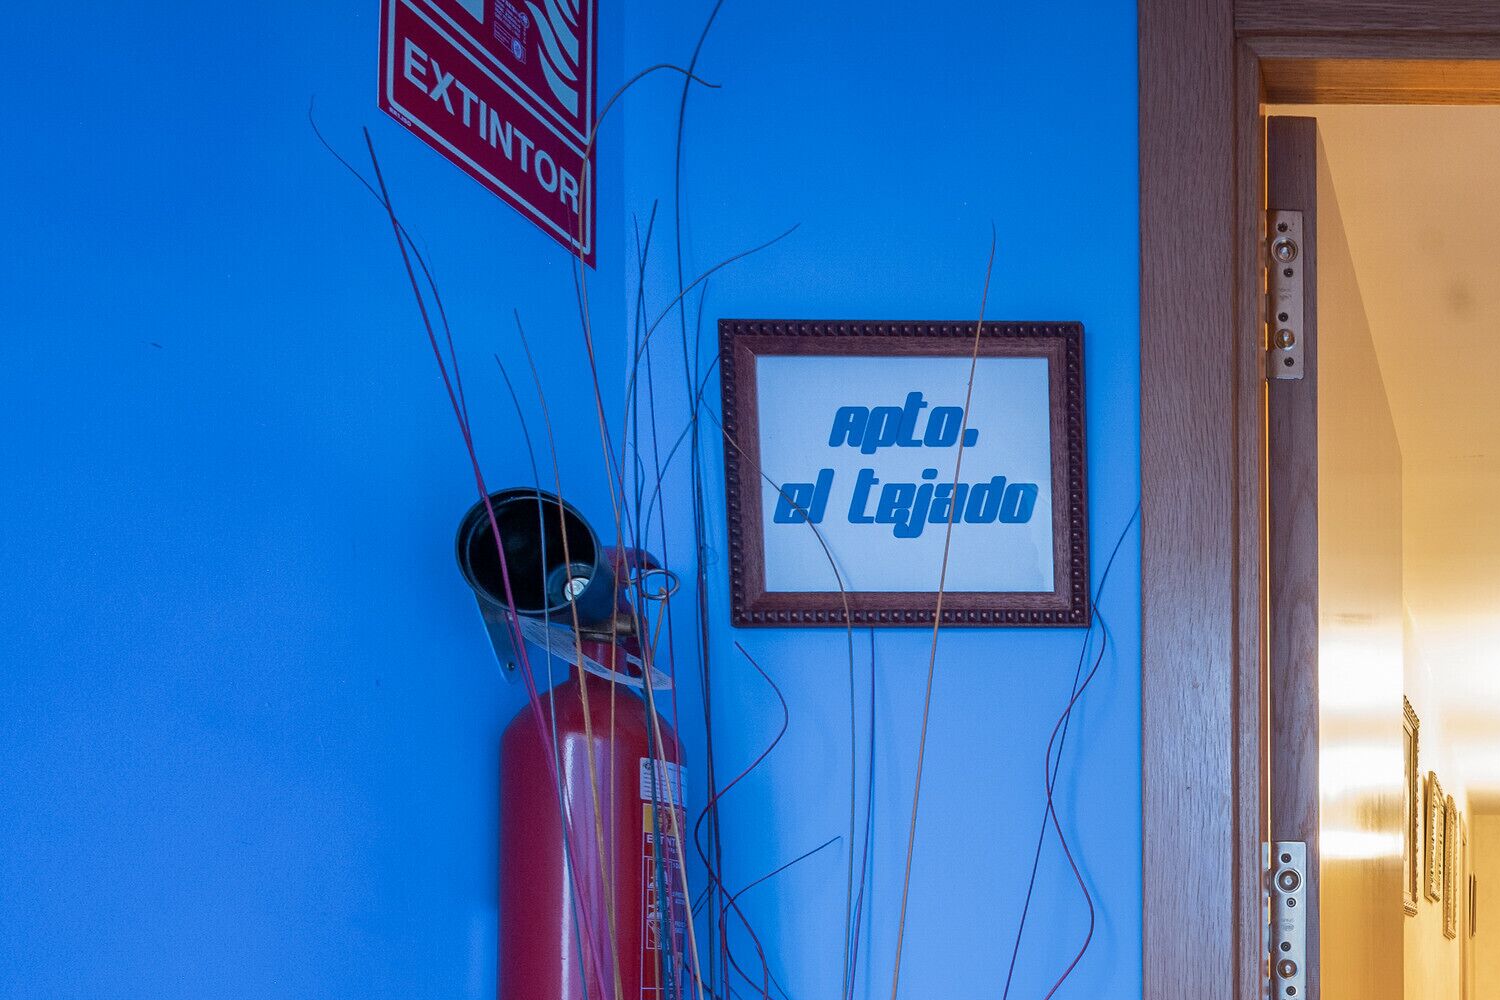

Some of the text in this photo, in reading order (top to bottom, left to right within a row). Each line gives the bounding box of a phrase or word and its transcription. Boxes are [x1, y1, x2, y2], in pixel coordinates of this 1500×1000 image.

[403, 36, 580, 215] EXTINTOR
[773, 468, 1039, 539] el tejado
